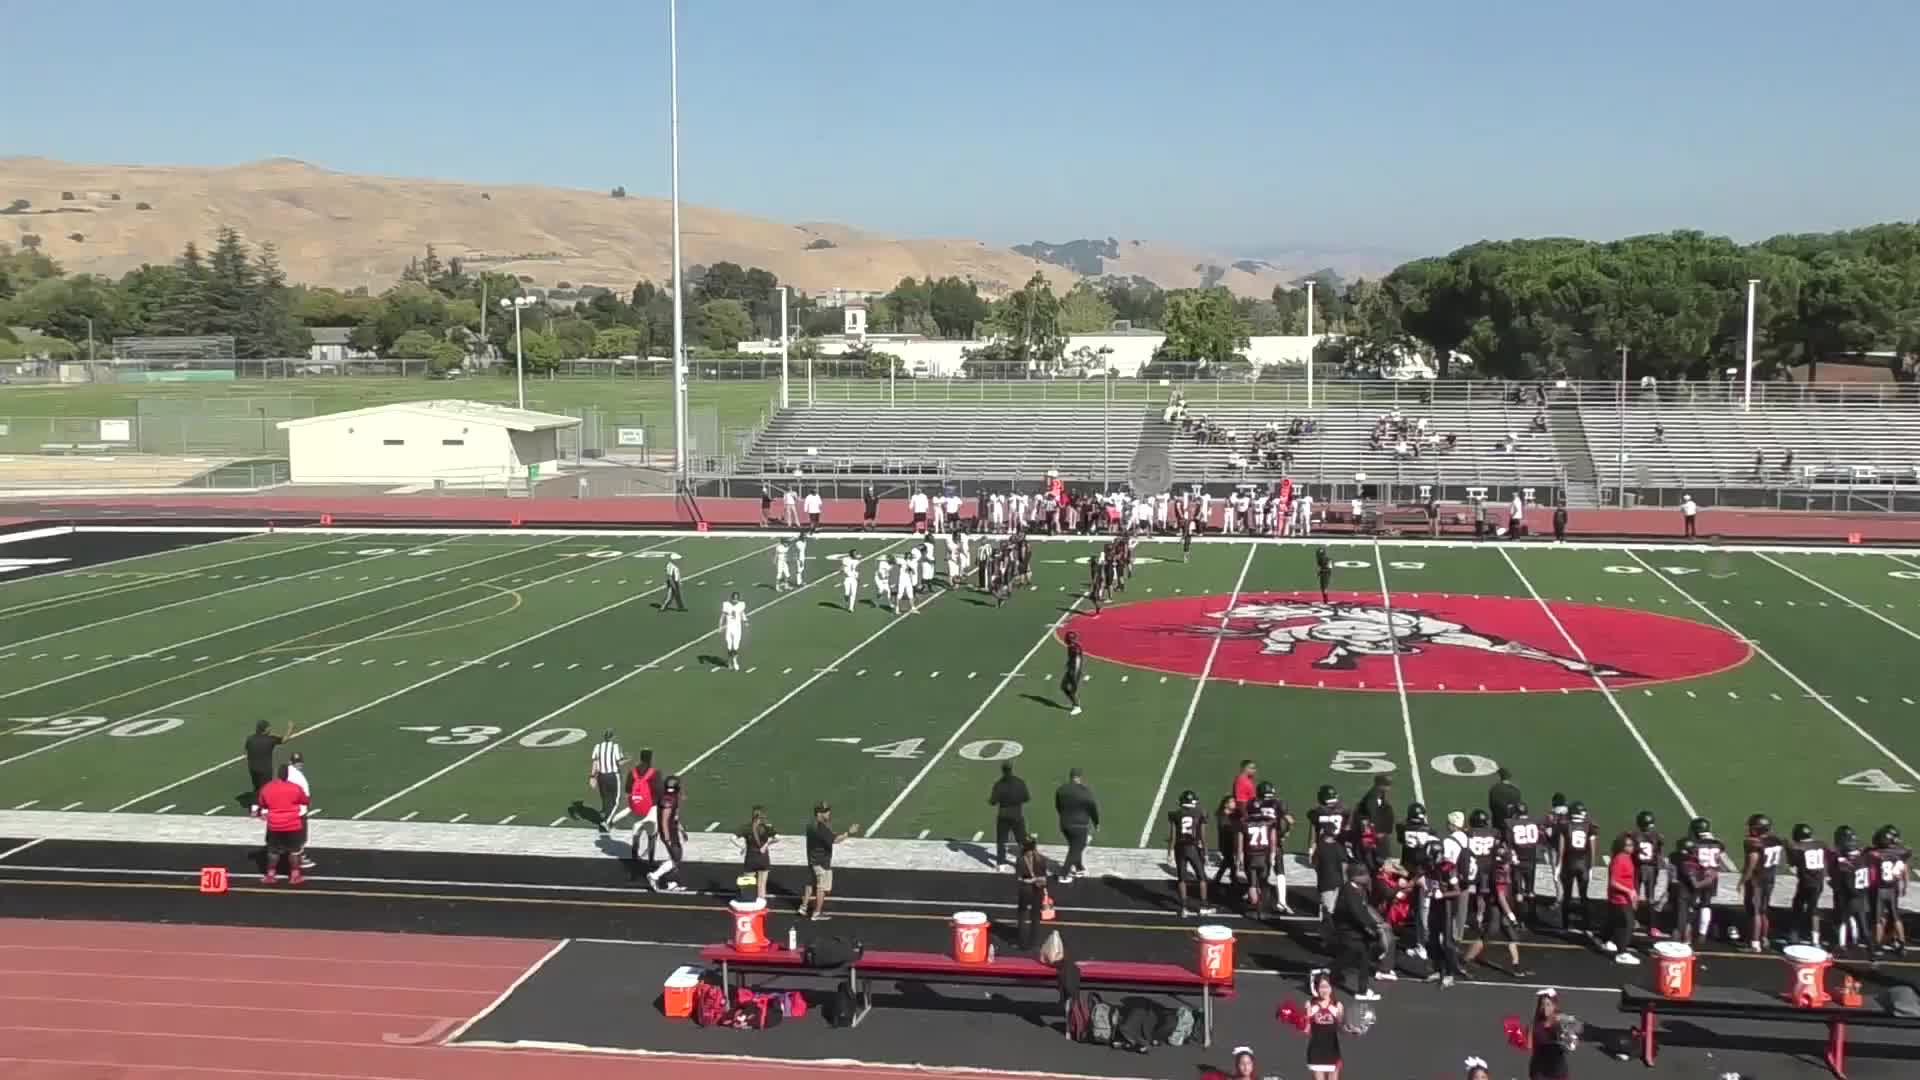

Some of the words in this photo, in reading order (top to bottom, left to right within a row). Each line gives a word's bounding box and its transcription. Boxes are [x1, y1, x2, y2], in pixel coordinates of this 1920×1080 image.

[1181, 816, 1193, 835] 2
[1512, 823, 1539, 845] 20
[1248, 826, 1270, 846] 71
[1571, 830, 1587, 848] 6
[1638, 841, 1653, 860] 3
[203, 870, 222, 889] 30
[737, 916, 753, 932] G
[1797, 968, 1815, 985] G
